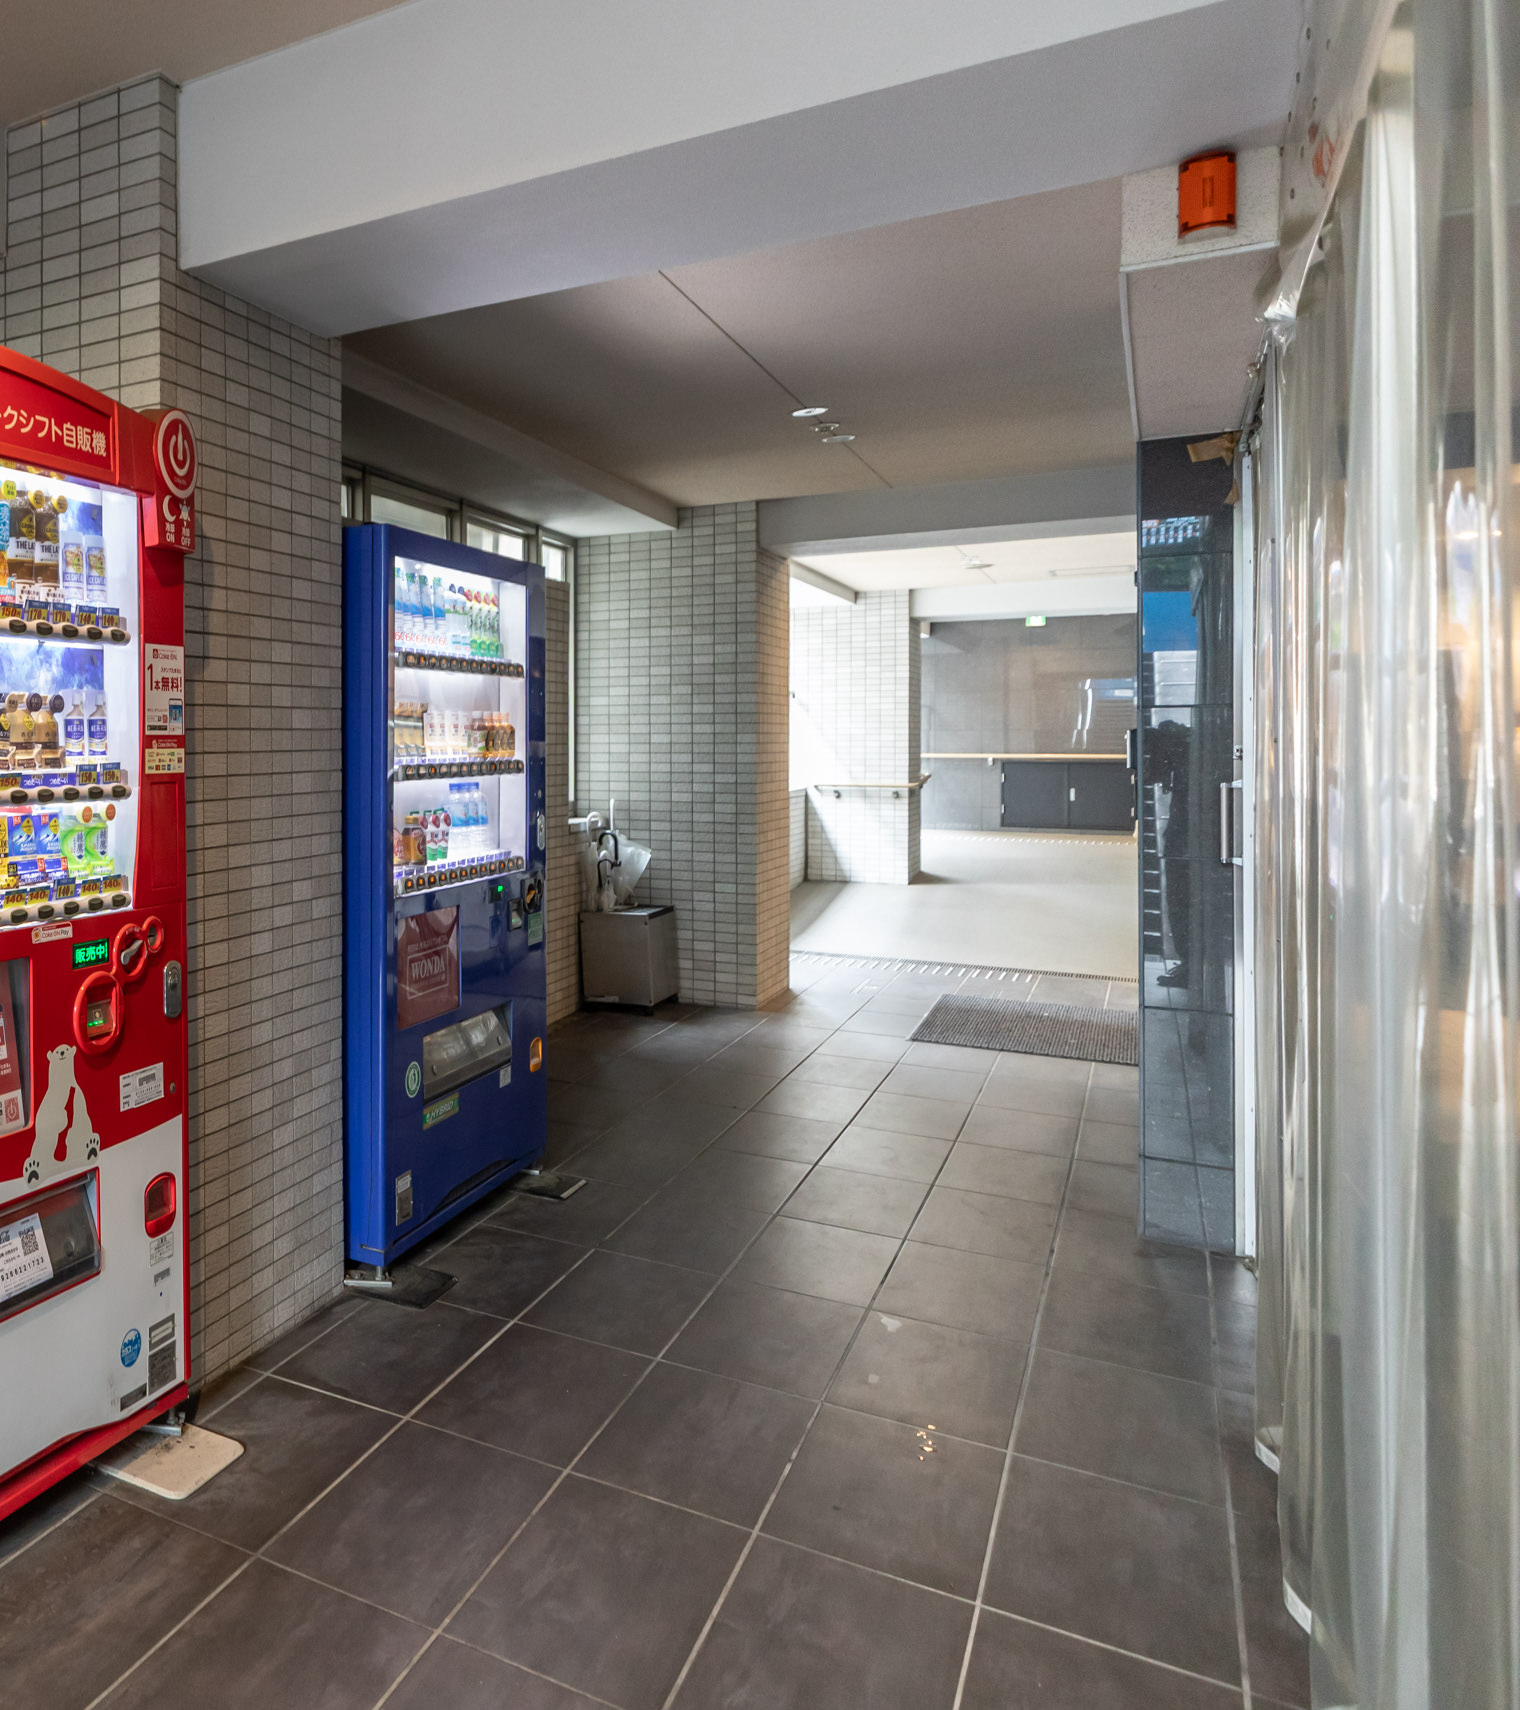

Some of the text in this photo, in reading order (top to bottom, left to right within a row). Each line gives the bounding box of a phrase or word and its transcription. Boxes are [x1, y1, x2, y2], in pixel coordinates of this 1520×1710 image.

[165, 532, 175, 543] ON
[181, 536, 191, 547] OFF
[411, 954, 445, 981] WONDA
